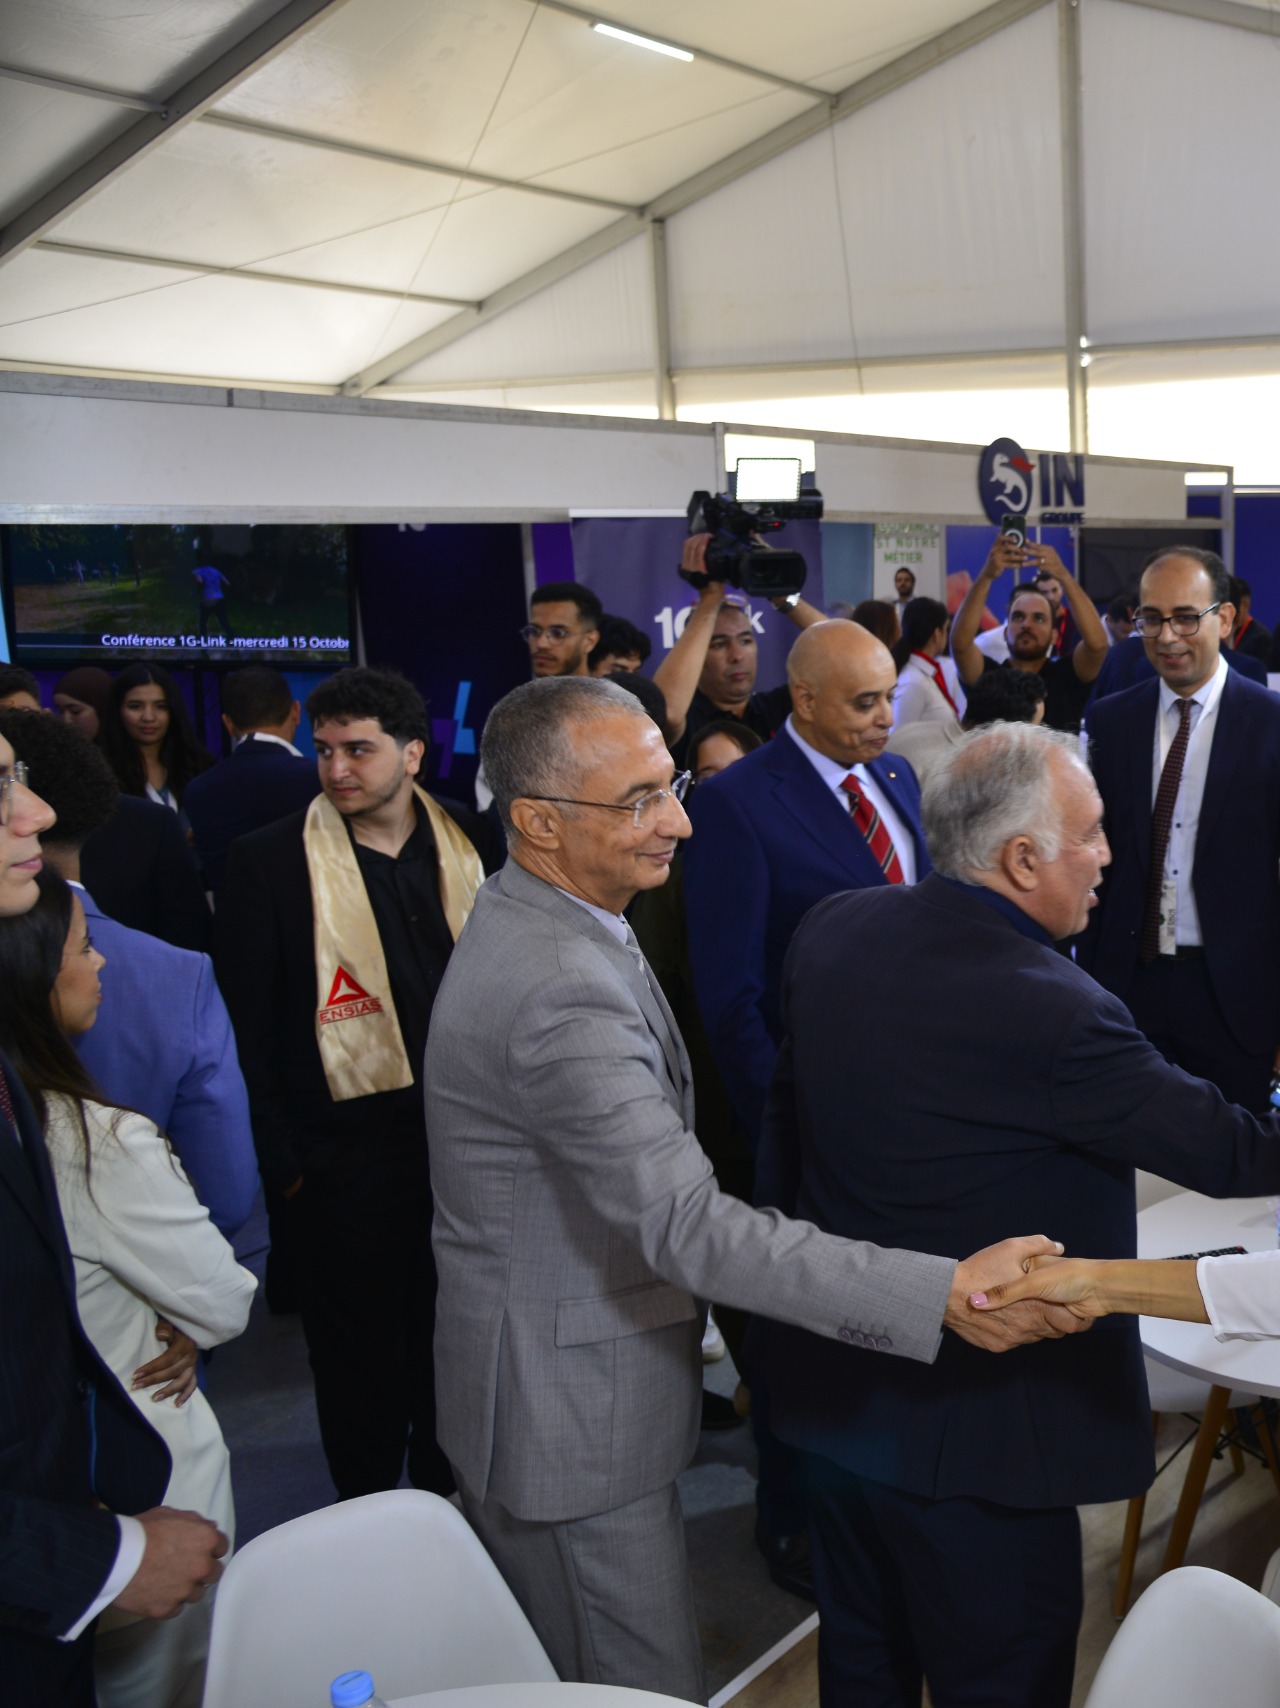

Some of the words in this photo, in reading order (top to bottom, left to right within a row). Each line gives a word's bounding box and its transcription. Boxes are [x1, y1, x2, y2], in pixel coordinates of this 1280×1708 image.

[1039, 453, 1085, 507] IN
[101, 634, 176, 647] Conférence
[179, 635, 227, 648] 1G-Link
[292, 636, 308, 649] 15
[319, 999, 383, 1024] ENSIAS
